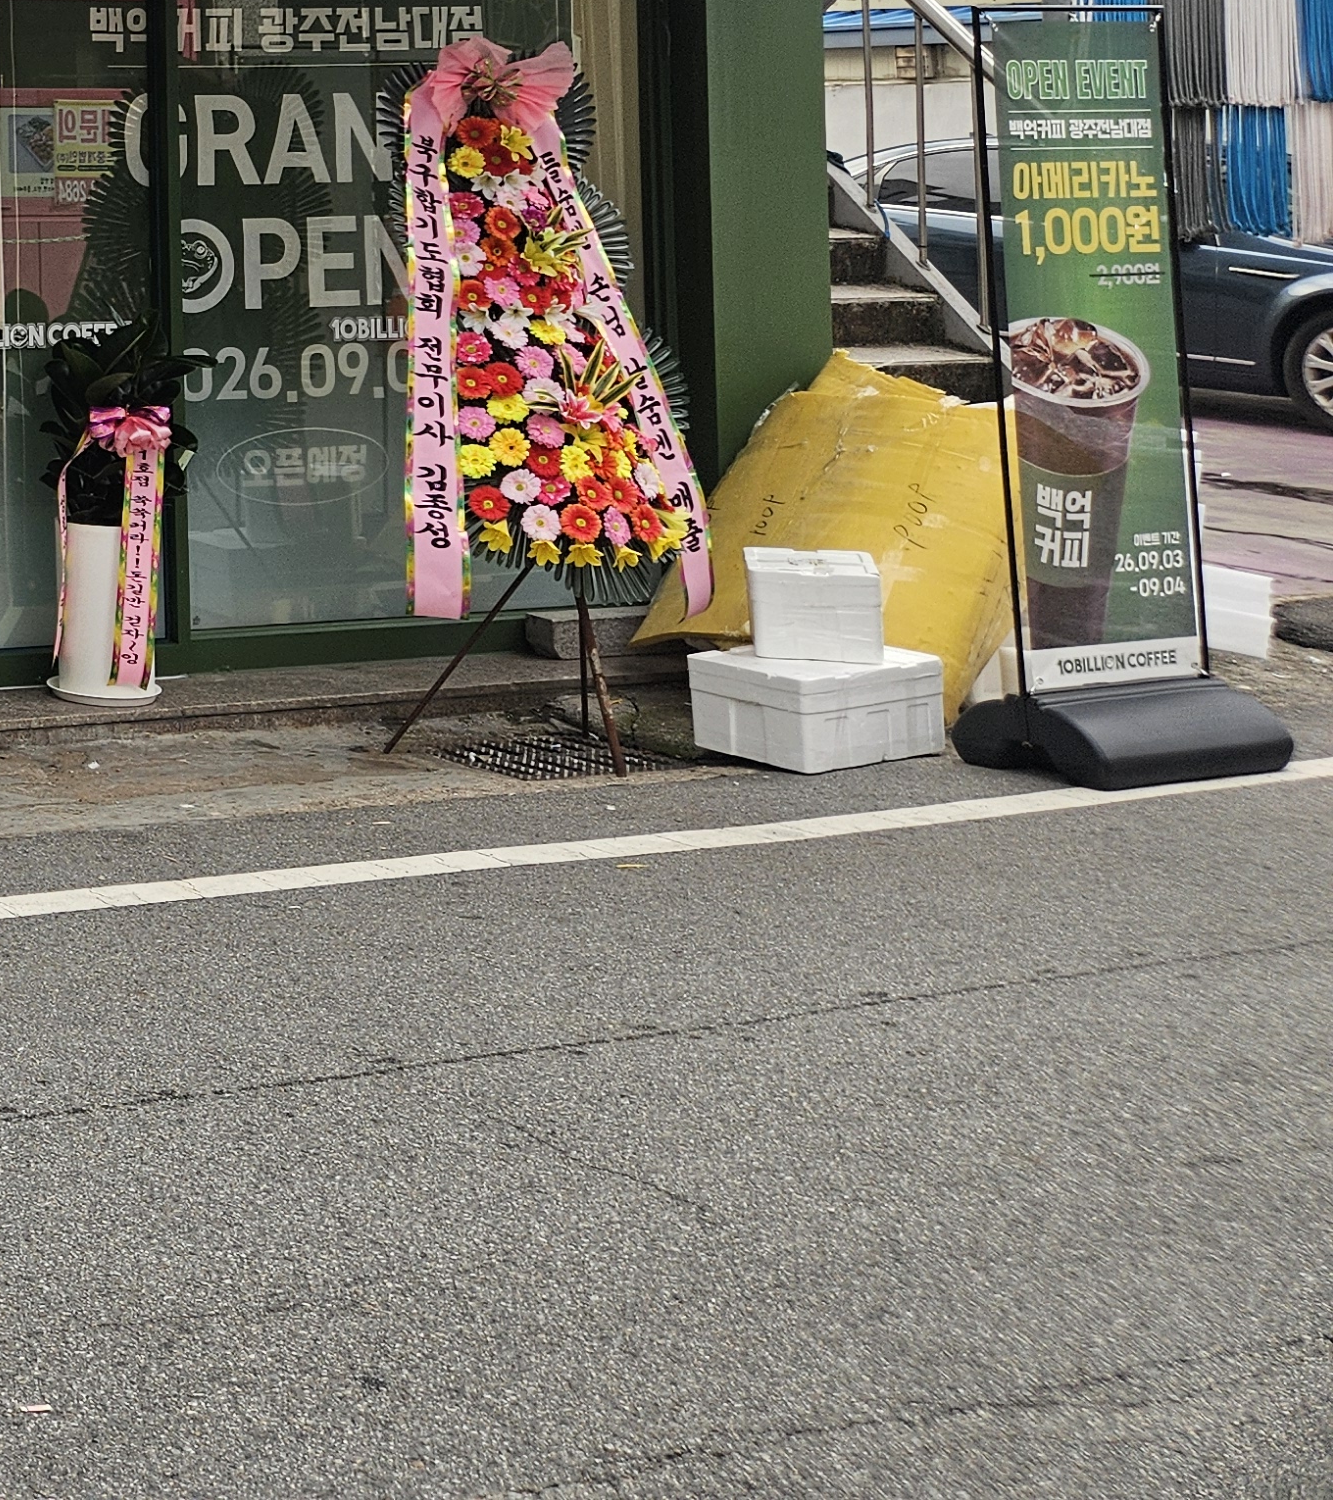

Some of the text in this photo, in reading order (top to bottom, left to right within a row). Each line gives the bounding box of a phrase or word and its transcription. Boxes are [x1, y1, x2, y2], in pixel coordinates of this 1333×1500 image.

[1006, 60, 1147, 100] OPEN EVENT
[125, 92, 394, 187] GRAN
[1009, 118, 1152, 139] 백억커피 광주전남대점
[1013, 161, 1157, 199] 아메리카노
[1015, 205, 1161, 265] 1,000원
[588, 272, 627, 338] 손님
[329, 316, 409, 342] 10BILLI
[413, 336, 454, 447] 전무이사
[242, 445, 366, 488] 오픈예정
[1037, 484, 1092, 530] 백억
[1035, 524, 1089, 567] 커피
[1134, 531, 1181, 547] 이벤트 기간
[1115, 550, 1184, 573] 26.09.03
[1130, 577, 1186, 598] -09.04
[1058, 650, 1177, 675] 10BILLION COFFEE
